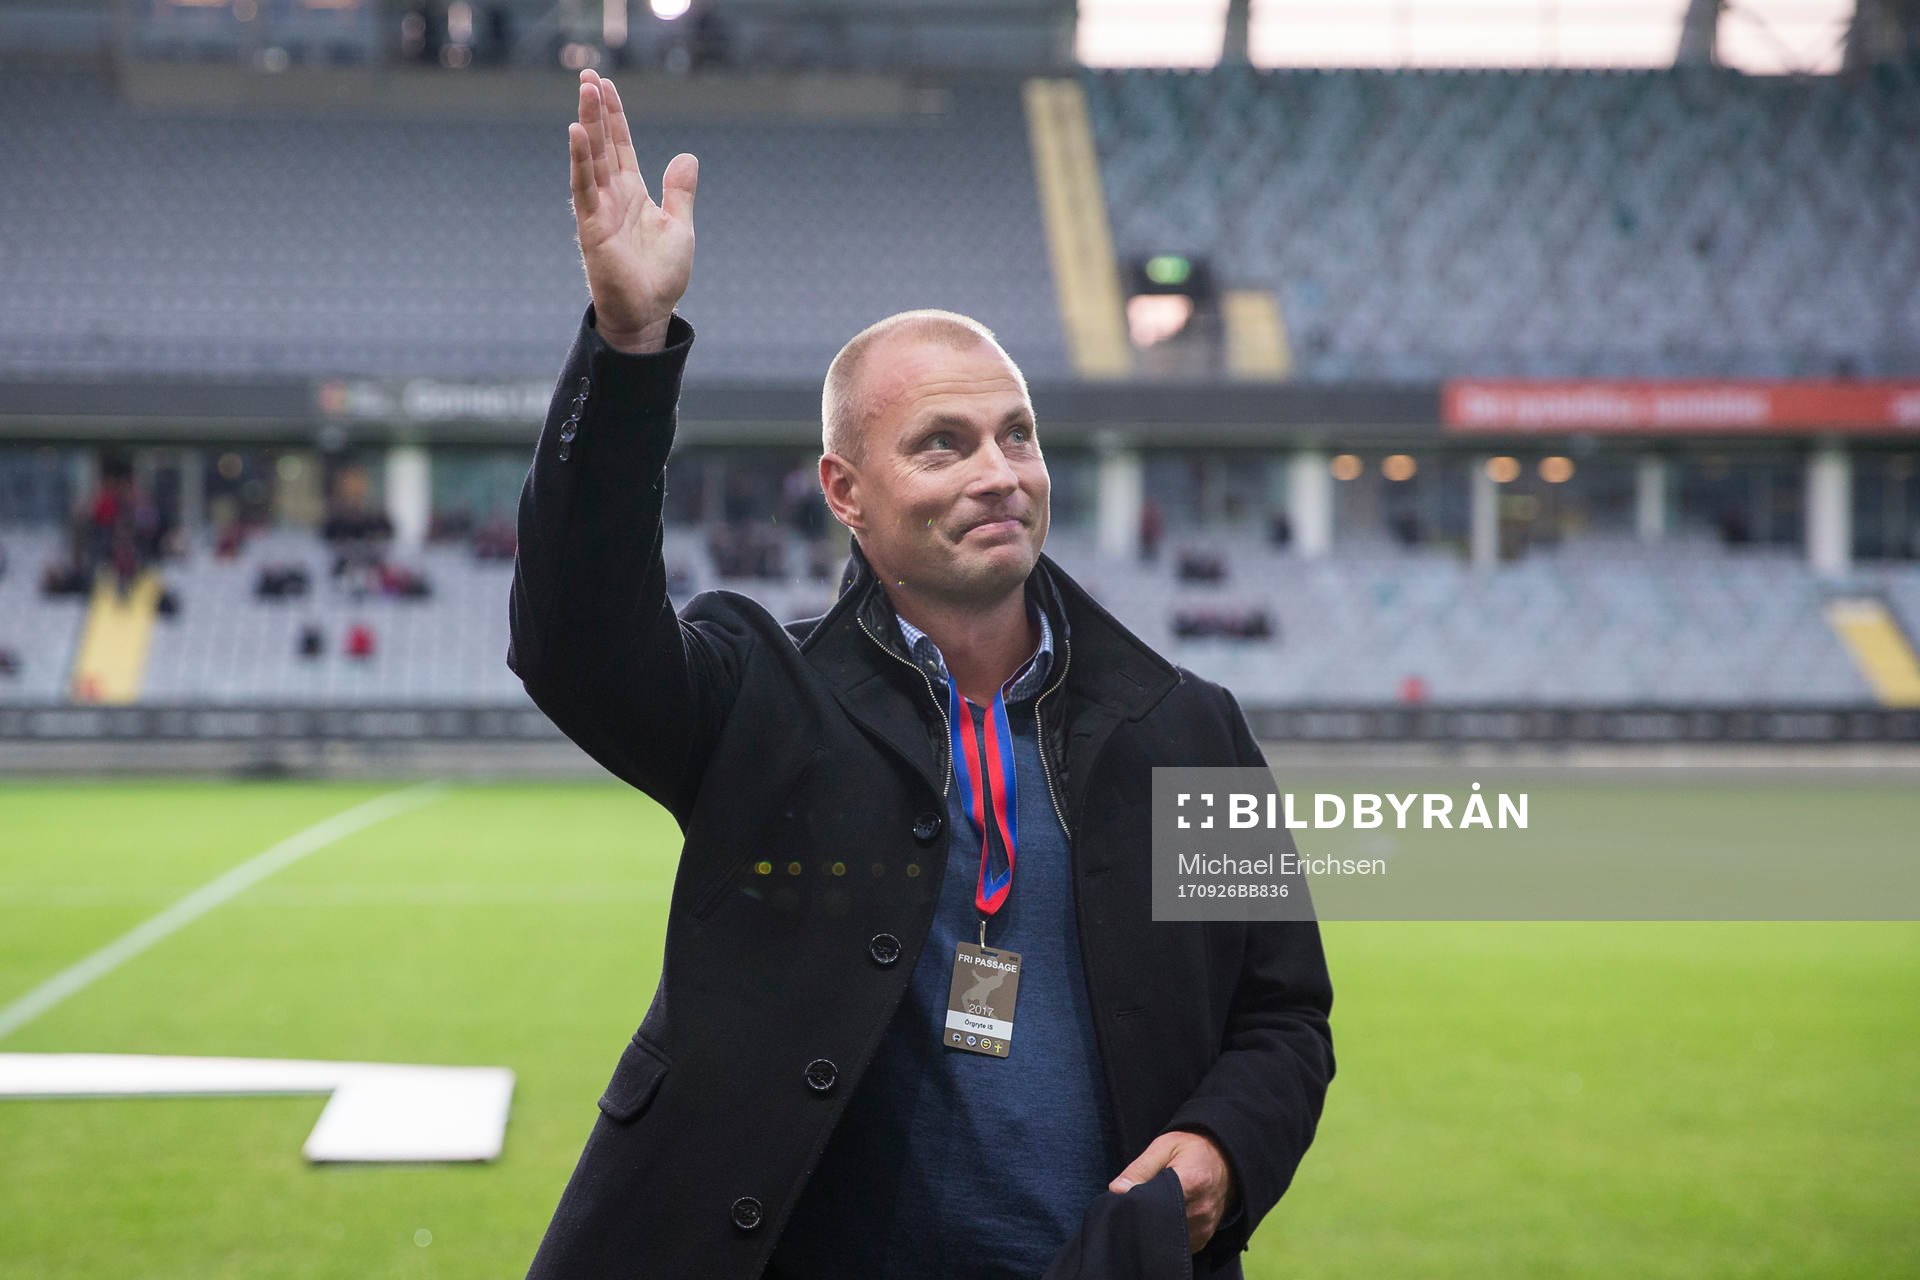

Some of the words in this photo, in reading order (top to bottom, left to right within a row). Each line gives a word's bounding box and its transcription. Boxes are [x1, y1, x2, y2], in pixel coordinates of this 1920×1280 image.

[958, 953, 973, 964] FRI
[974, 957, 1018, 972] PASSAGE
[968, 1003, 994, 1017] 2017
